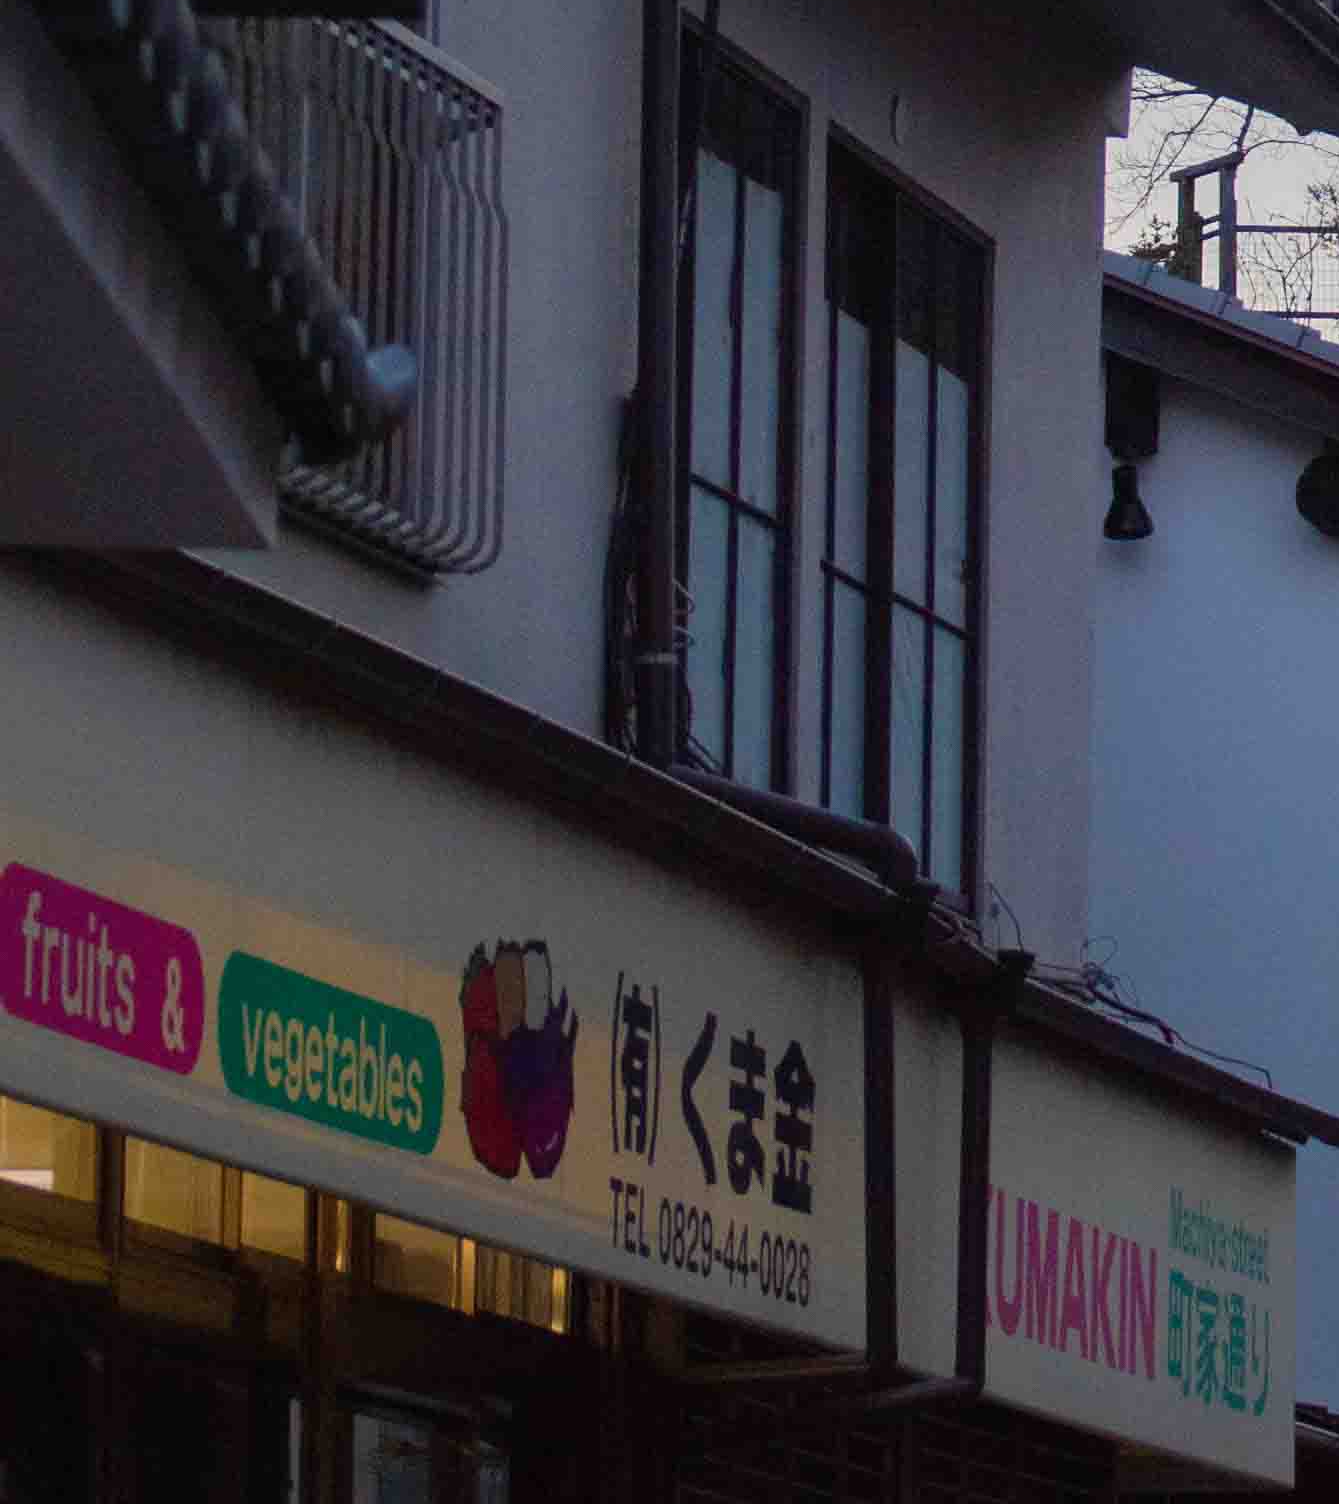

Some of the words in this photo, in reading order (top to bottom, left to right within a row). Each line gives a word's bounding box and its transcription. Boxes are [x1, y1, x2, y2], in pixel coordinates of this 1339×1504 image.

[21, 889, 137, 1037] fruits
[160, 955, 188, 1056] &
[240, 1001, 426, 1136] vegetables
[609, 1175, 651, 1259] TEL
[658, 1197, 811, 1308] 0829-44-0028
[983, 1182, 1158, 1381] UMAKIN
[1167, 1268, 1273, 1417] 町家通り
